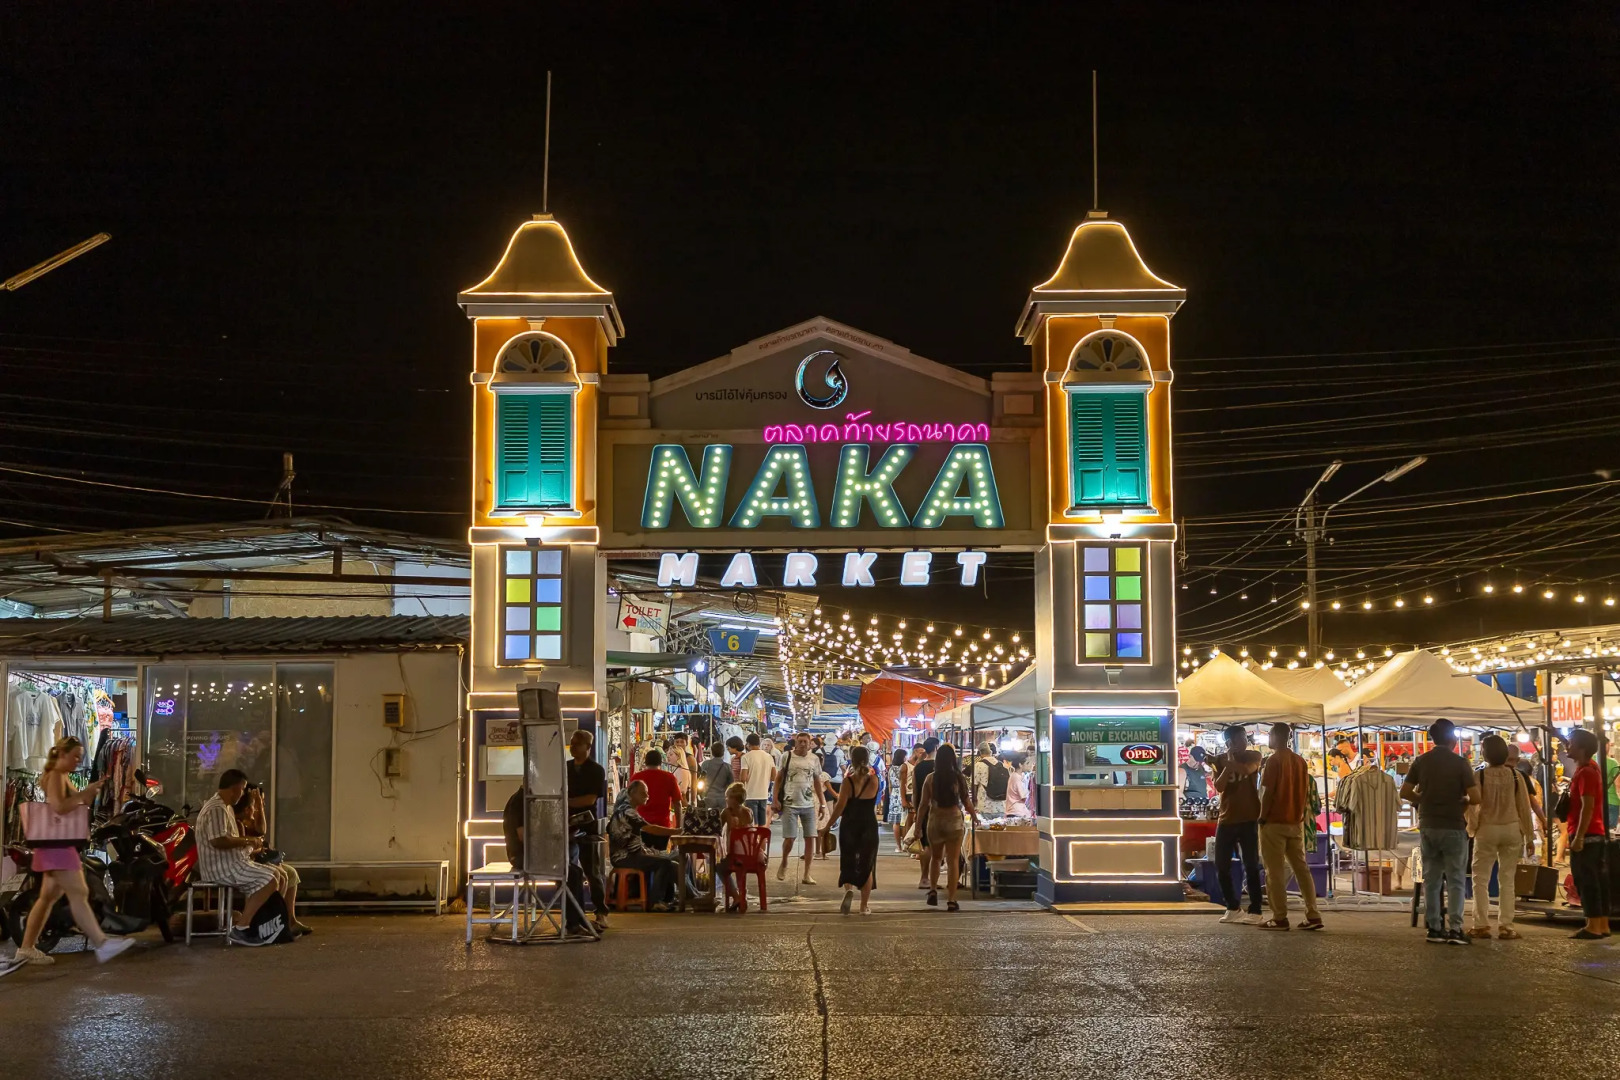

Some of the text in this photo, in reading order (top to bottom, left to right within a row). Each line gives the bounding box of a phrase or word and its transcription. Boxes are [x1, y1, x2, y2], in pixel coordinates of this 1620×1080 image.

[695, 388, 788, 403] บารมีไอ้ไข่คุ้มครอง
[763, 410, 991, 443] ตลาดท้ายรถนาคา
[640, 443, 1006, 529] NAKA
[656, 550, 989, 588] MARKET
[626, 604, 661, 617] TOILET
[728, 635, 740, 650] 6
[1072, 731, 1158, 742] MONEY EXCHANGE
[1126, 749, 1158, 760] OPEN
[258, 913, 282, 940] NIKE
